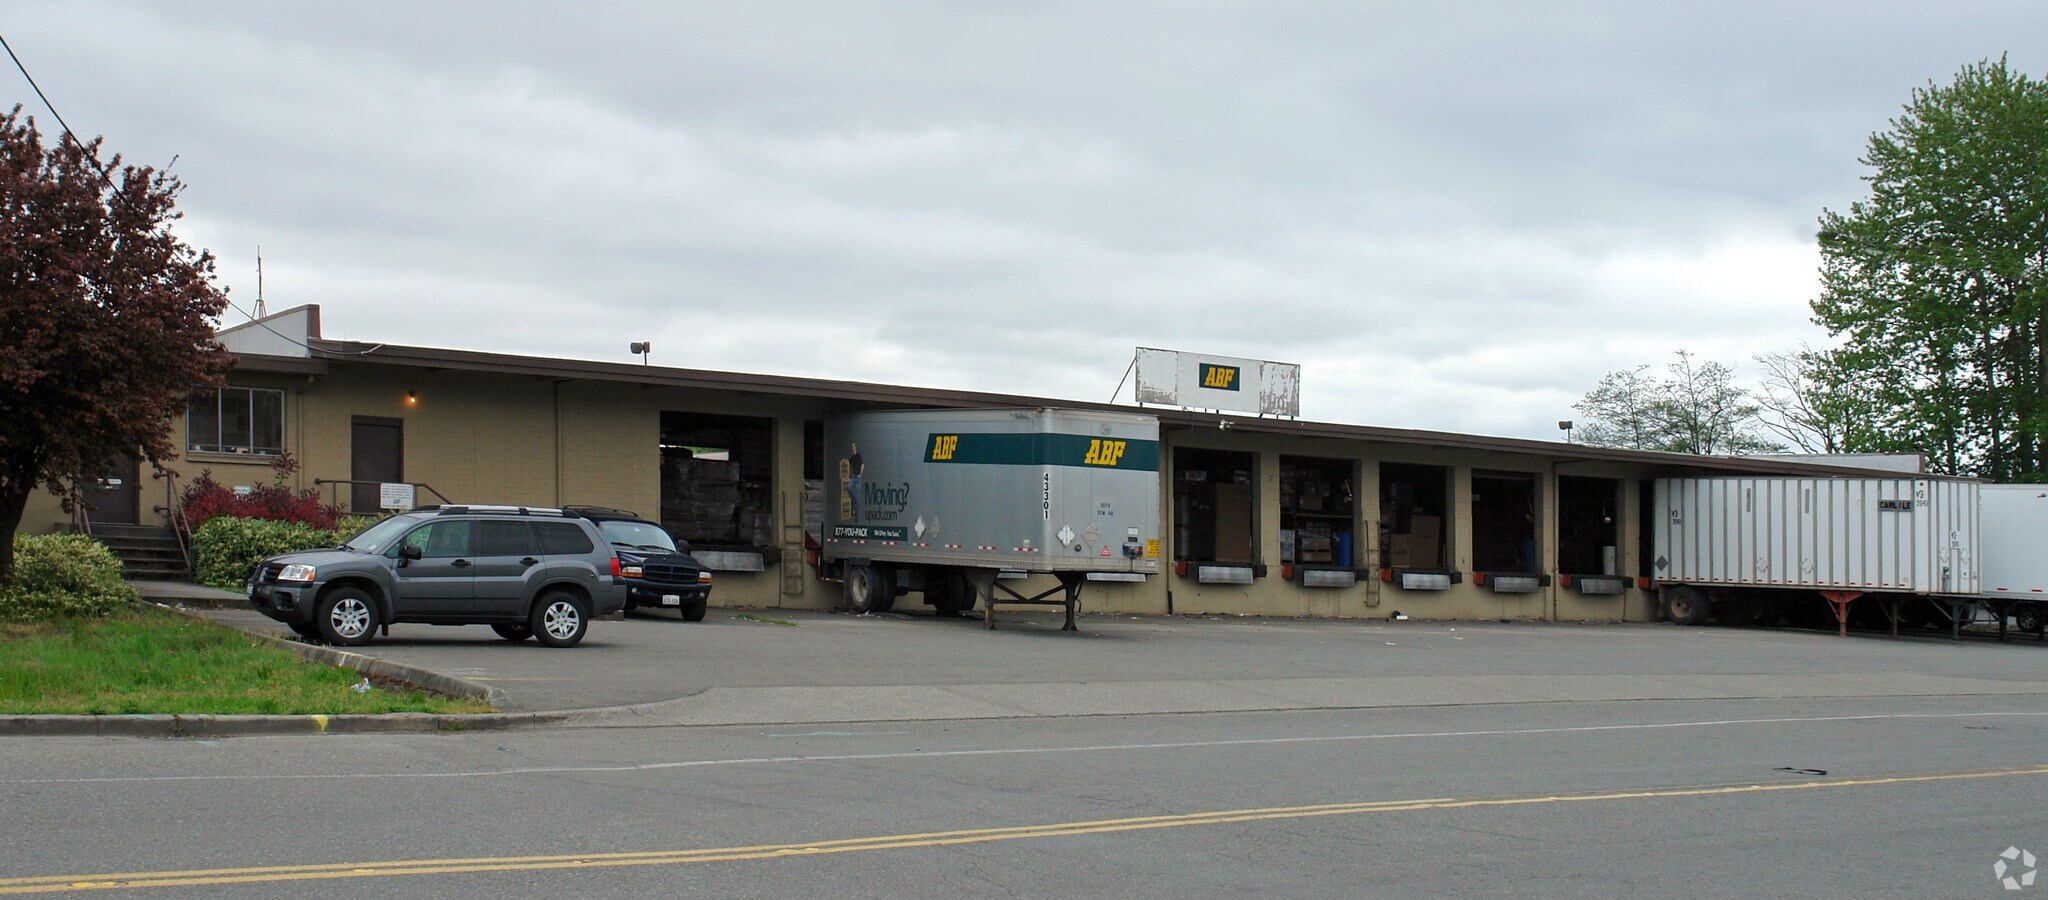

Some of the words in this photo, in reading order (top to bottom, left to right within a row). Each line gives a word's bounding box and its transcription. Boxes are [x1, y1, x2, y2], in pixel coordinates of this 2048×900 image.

[1204, 367, 1235, 388] ABF
[932, 436, 958, 460] ABF
[1084, 439, 1126, 466] ABF
[864, 482, 910, 512] Moving?
[864, 510, 898, 523] upack.com
